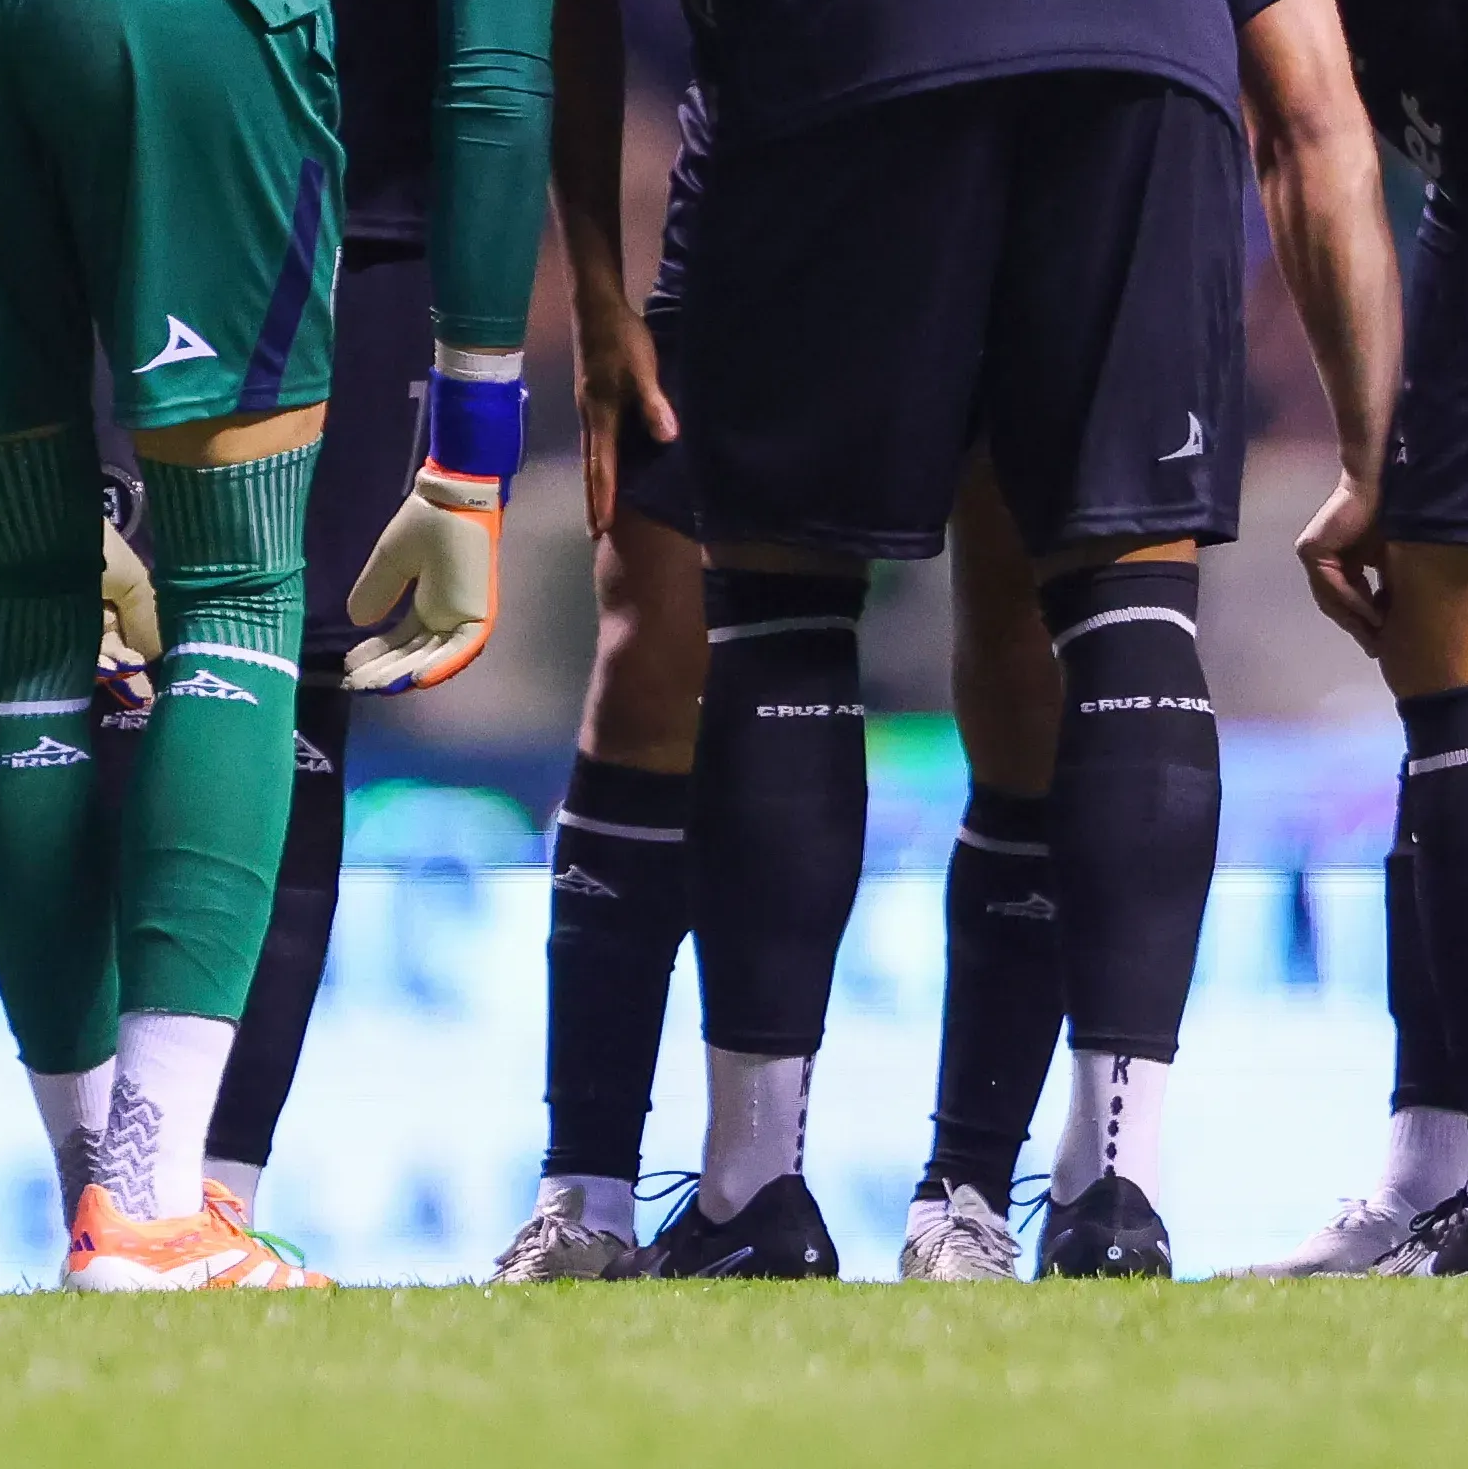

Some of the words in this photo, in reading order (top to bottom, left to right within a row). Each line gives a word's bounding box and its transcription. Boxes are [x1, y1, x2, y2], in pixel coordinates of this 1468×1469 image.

[756, 704, 831, 717] CRUZ
[834, 704, 865, 716] AZ
[1079, 695, 1152, 713] CRUZ
[1156, 696, 1216, 714] AZUL
